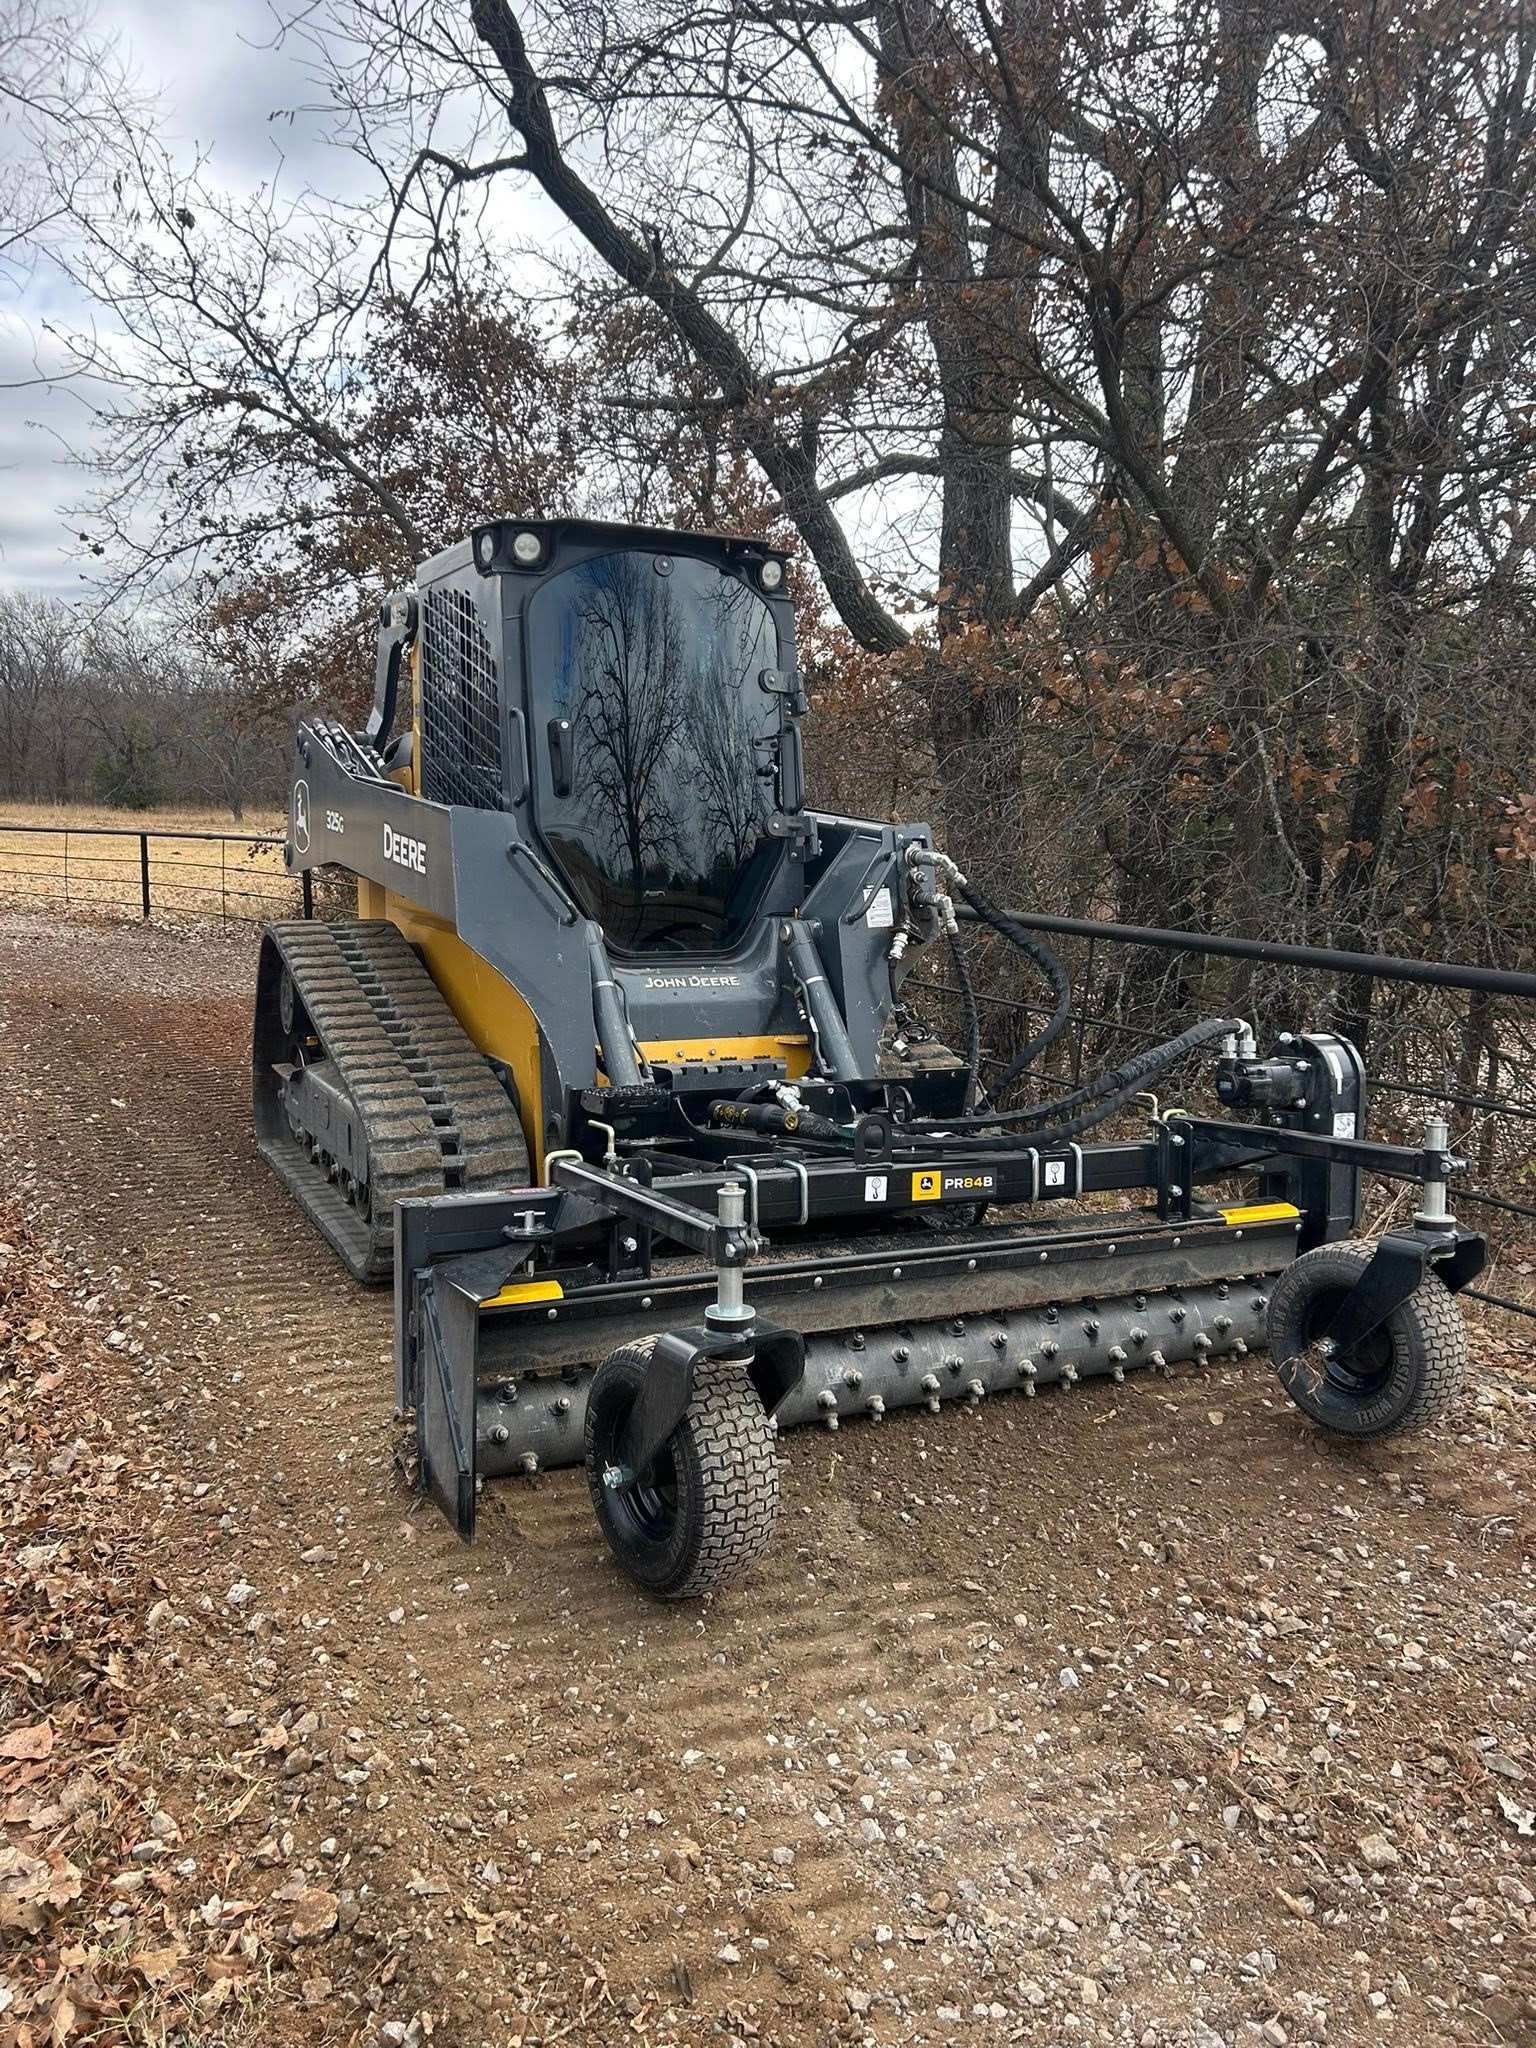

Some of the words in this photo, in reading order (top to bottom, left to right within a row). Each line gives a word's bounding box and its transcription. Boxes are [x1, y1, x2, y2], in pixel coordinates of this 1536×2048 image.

[326, 810, 344, 834] 325G
[383, 823, 427, 875] DEERE
[645, 977, 687, 988] JOHN
[689, 976, 740, 987] DEERE
[944, 1176, 993, 1190] PR84B
